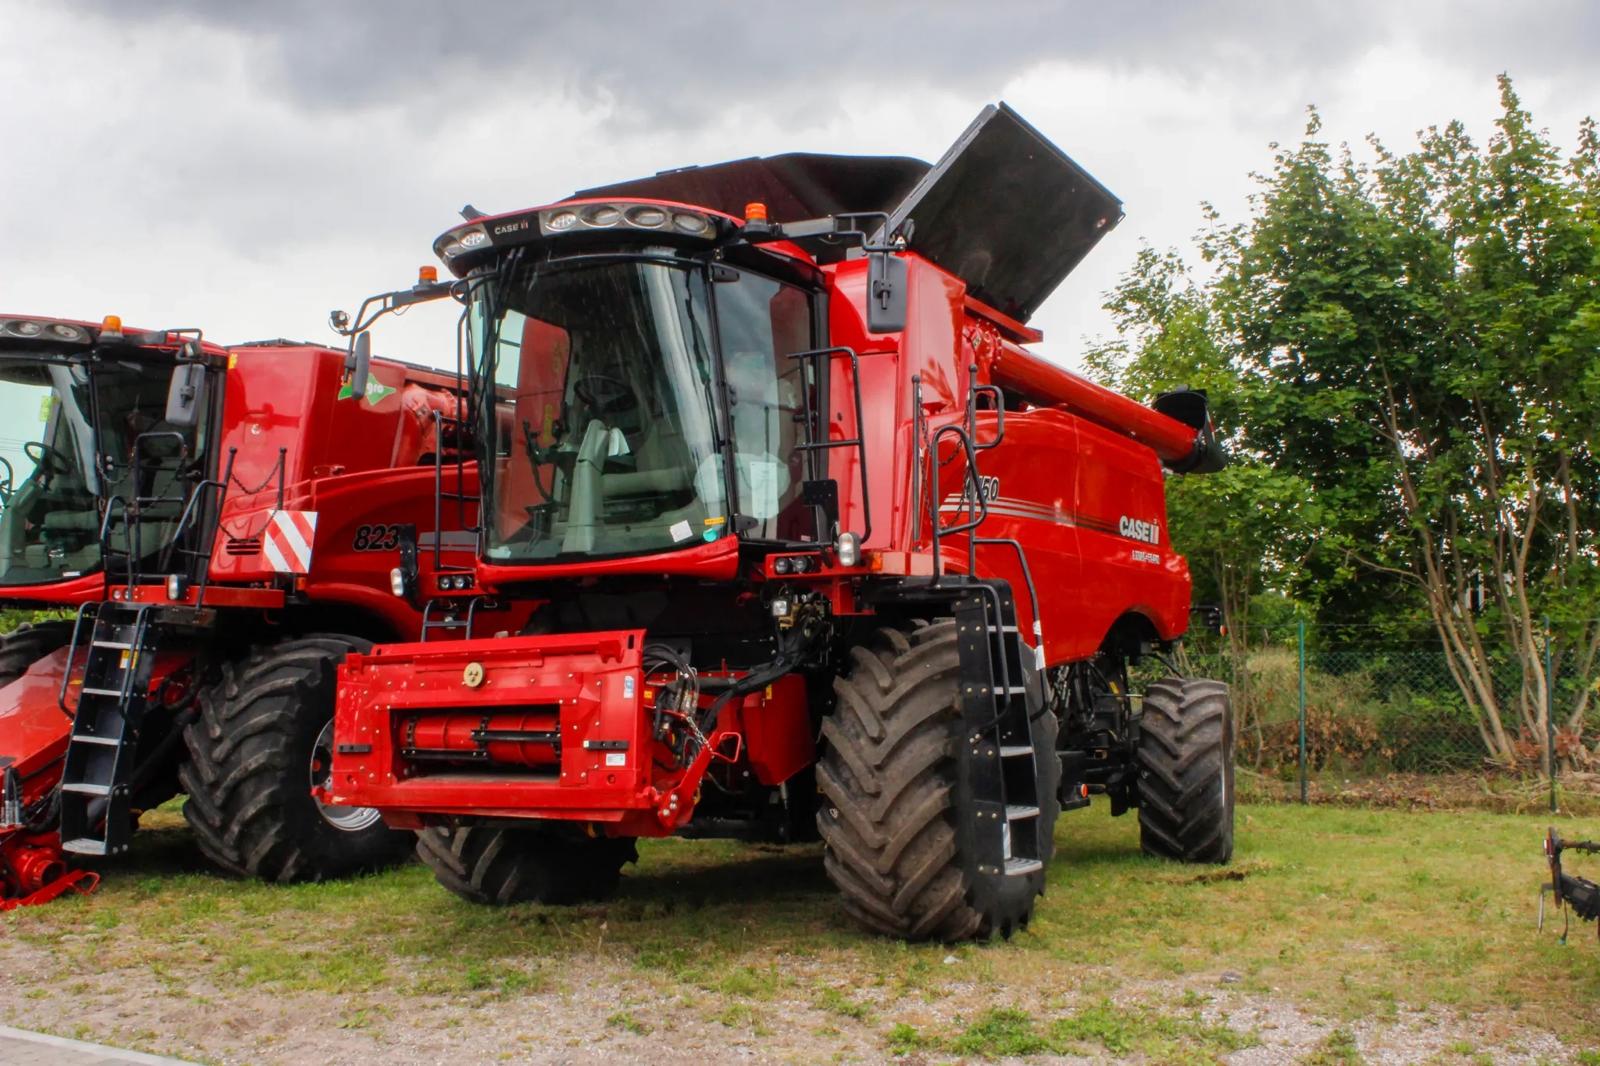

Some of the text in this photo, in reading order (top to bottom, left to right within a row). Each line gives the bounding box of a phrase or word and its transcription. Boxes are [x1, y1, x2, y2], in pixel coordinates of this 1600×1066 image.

[494, 224, 519, 234] CASE
[367, 382, 384, 395] gro
[352, 523, 402, 552] 823
[1120, 515, 1150, 542] CASE
